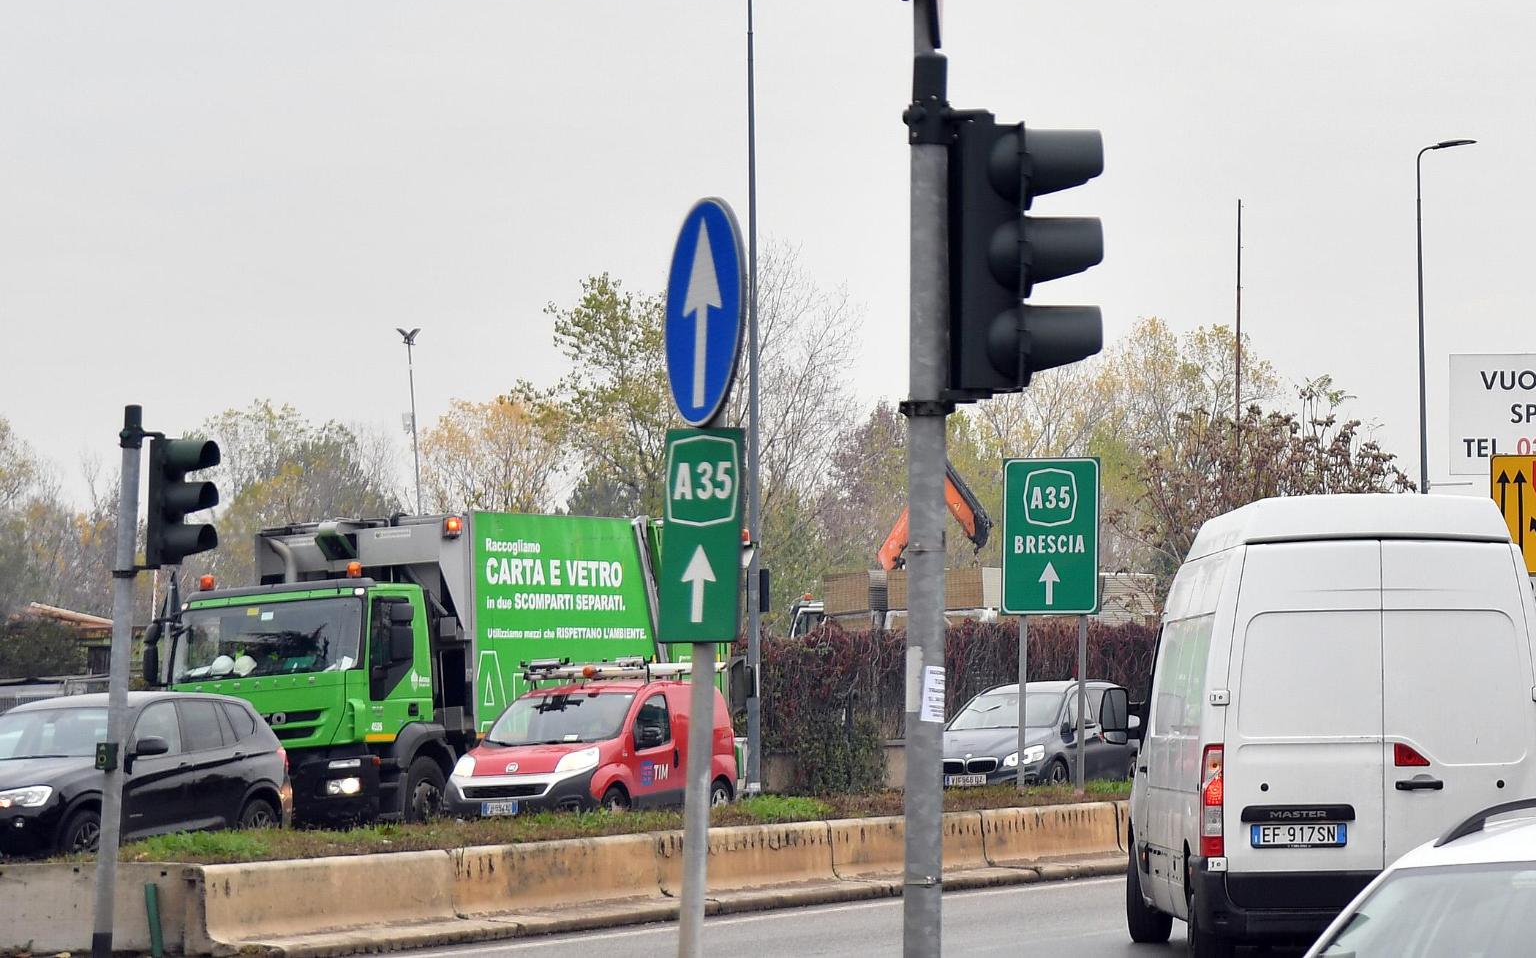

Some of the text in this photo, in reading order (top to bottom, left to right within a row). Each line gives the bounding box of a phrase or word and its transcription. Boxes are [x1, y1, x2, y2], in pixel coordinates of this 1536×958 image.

[673, 461, 733, 500] A35
[1030, 486, 1071, 509] A35
[485, 538, 541, 555] Raccogliamo
[1014, 534, 1085, 554] BRESCIA
[486, 557, 623, 587] CARTA E VETRO
[486, 593, 626, 611] in due SCOMPARTI SEPARATI.
[556, 627, 602, 639] RISPETTANO
[603, 627, 647, 639] L'AMBIENTE.
[653, 763, 669, 780] TIM
[1270, 810, 1327, 818] MASTER
[1262, 826, 1336, 843] EF 917SN
